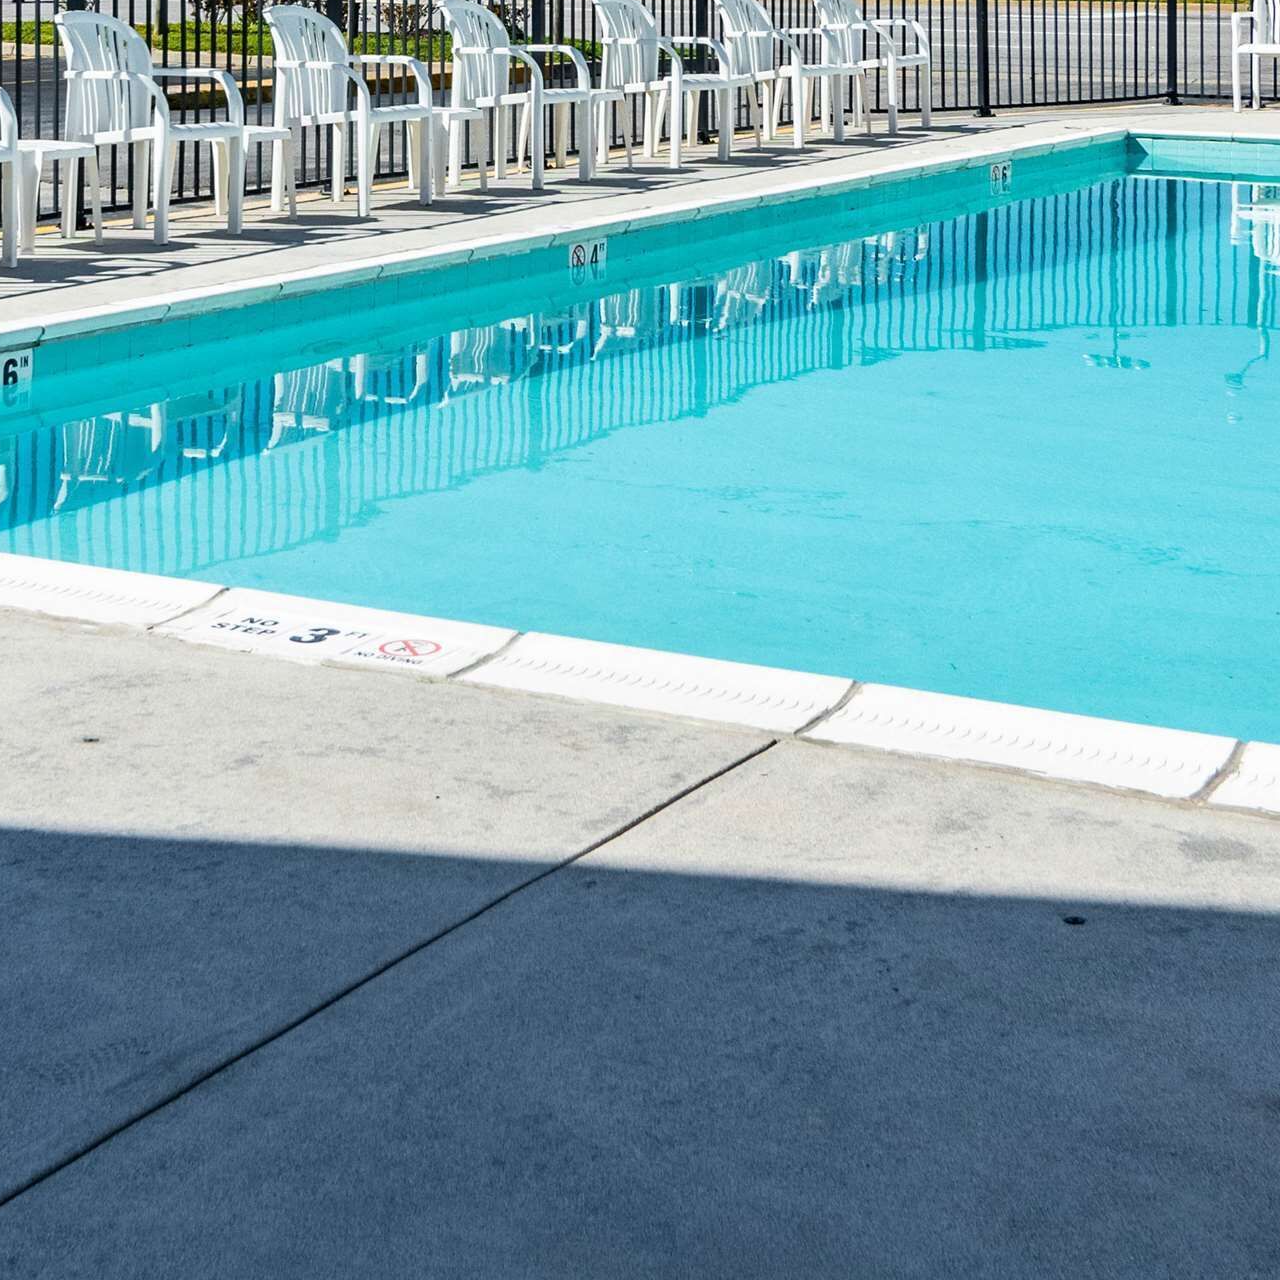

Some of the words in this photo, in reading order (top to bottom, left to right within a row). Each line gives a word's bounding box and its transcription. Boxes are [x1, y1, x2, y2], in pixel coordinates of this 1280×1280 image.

[590, 244, 599, 263] 4
[3, 358, 18, 385] 6
[20, 356, 29, 368] IN
[212, 622, 277, 636] STEP
[241, 617, 279, 626] NO
[289, 627, 341, 644] 3
[345, 630, 371, 639] FT
